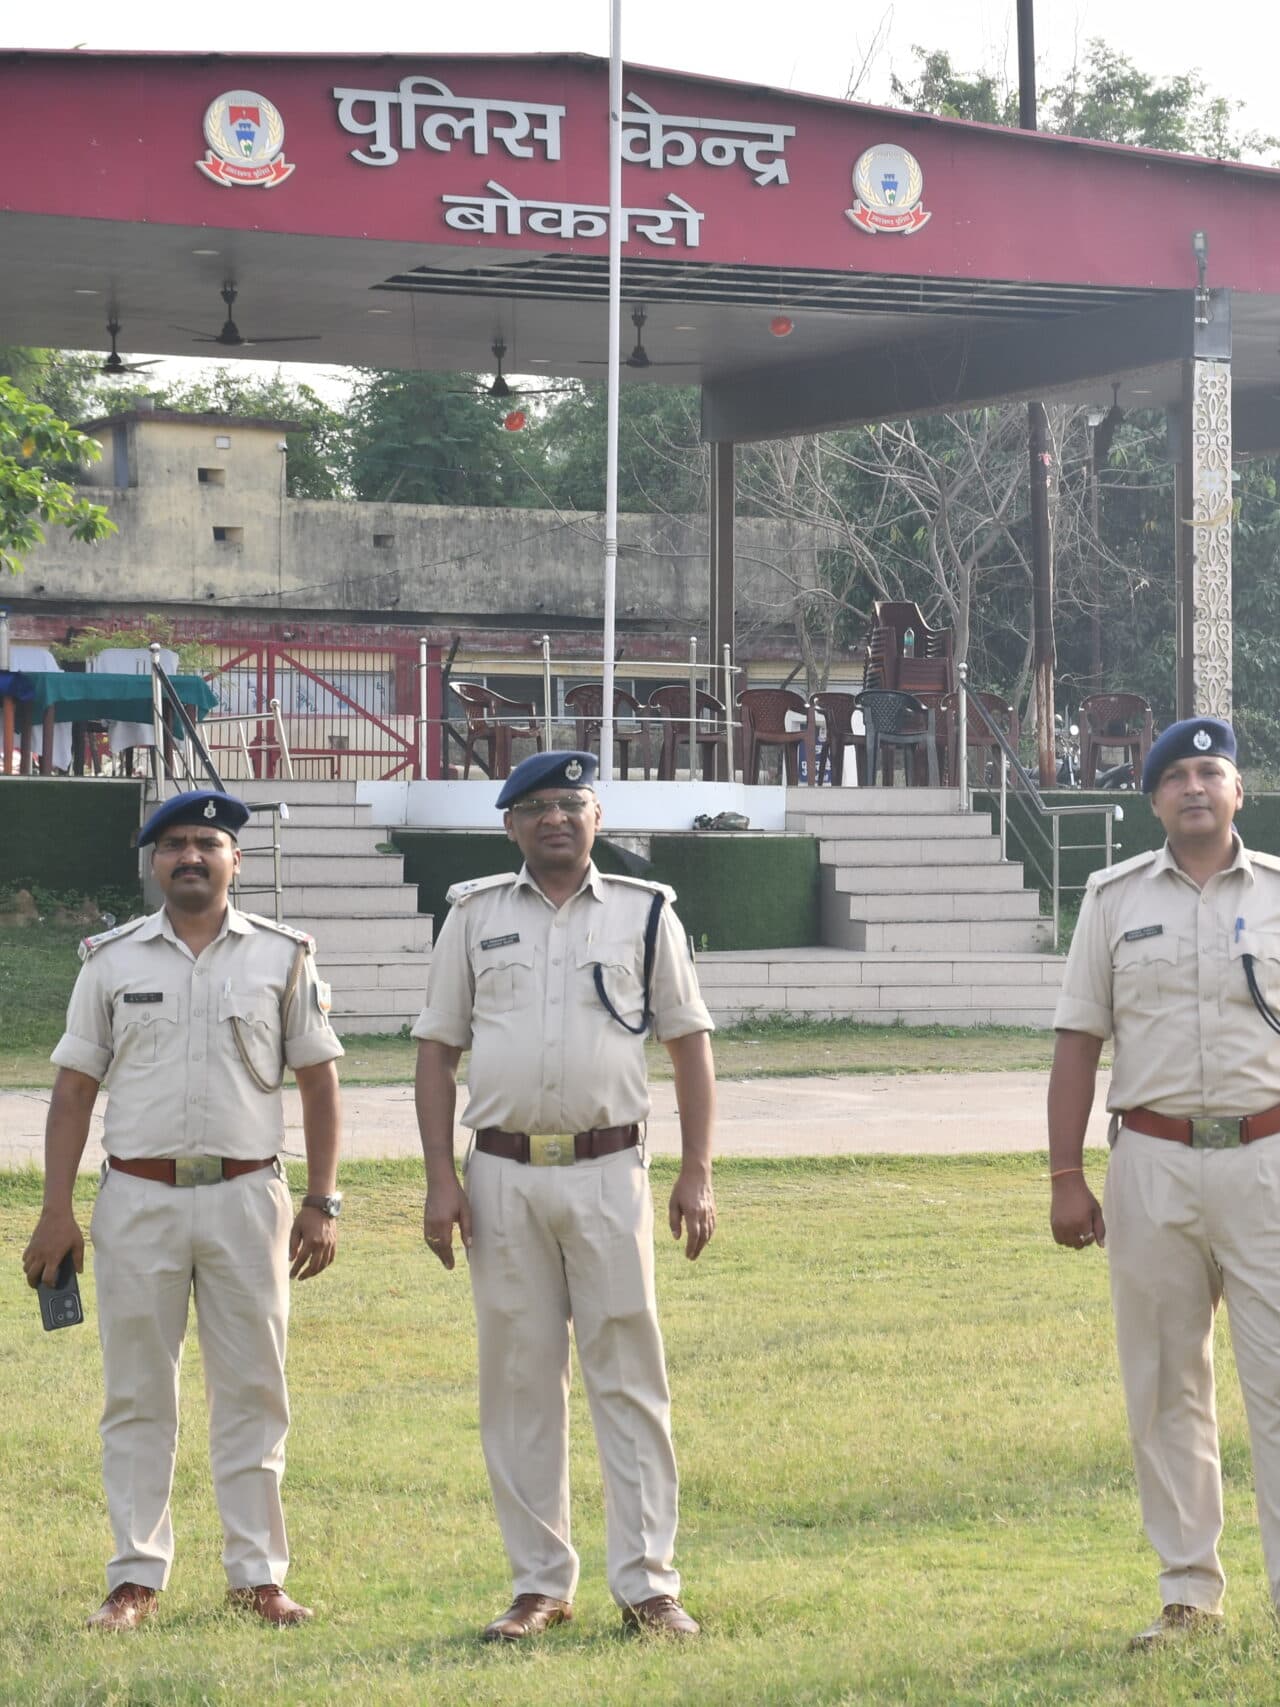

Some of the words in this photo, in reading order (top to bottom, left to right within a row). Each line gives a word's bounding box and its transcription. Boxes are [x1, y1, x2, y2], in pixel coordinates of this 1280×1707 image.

[333, 75, 566, 166] पुलिस
[621, 91, 796, 186] केन्द्र
[442, 180, 705, 247] बोकारो
